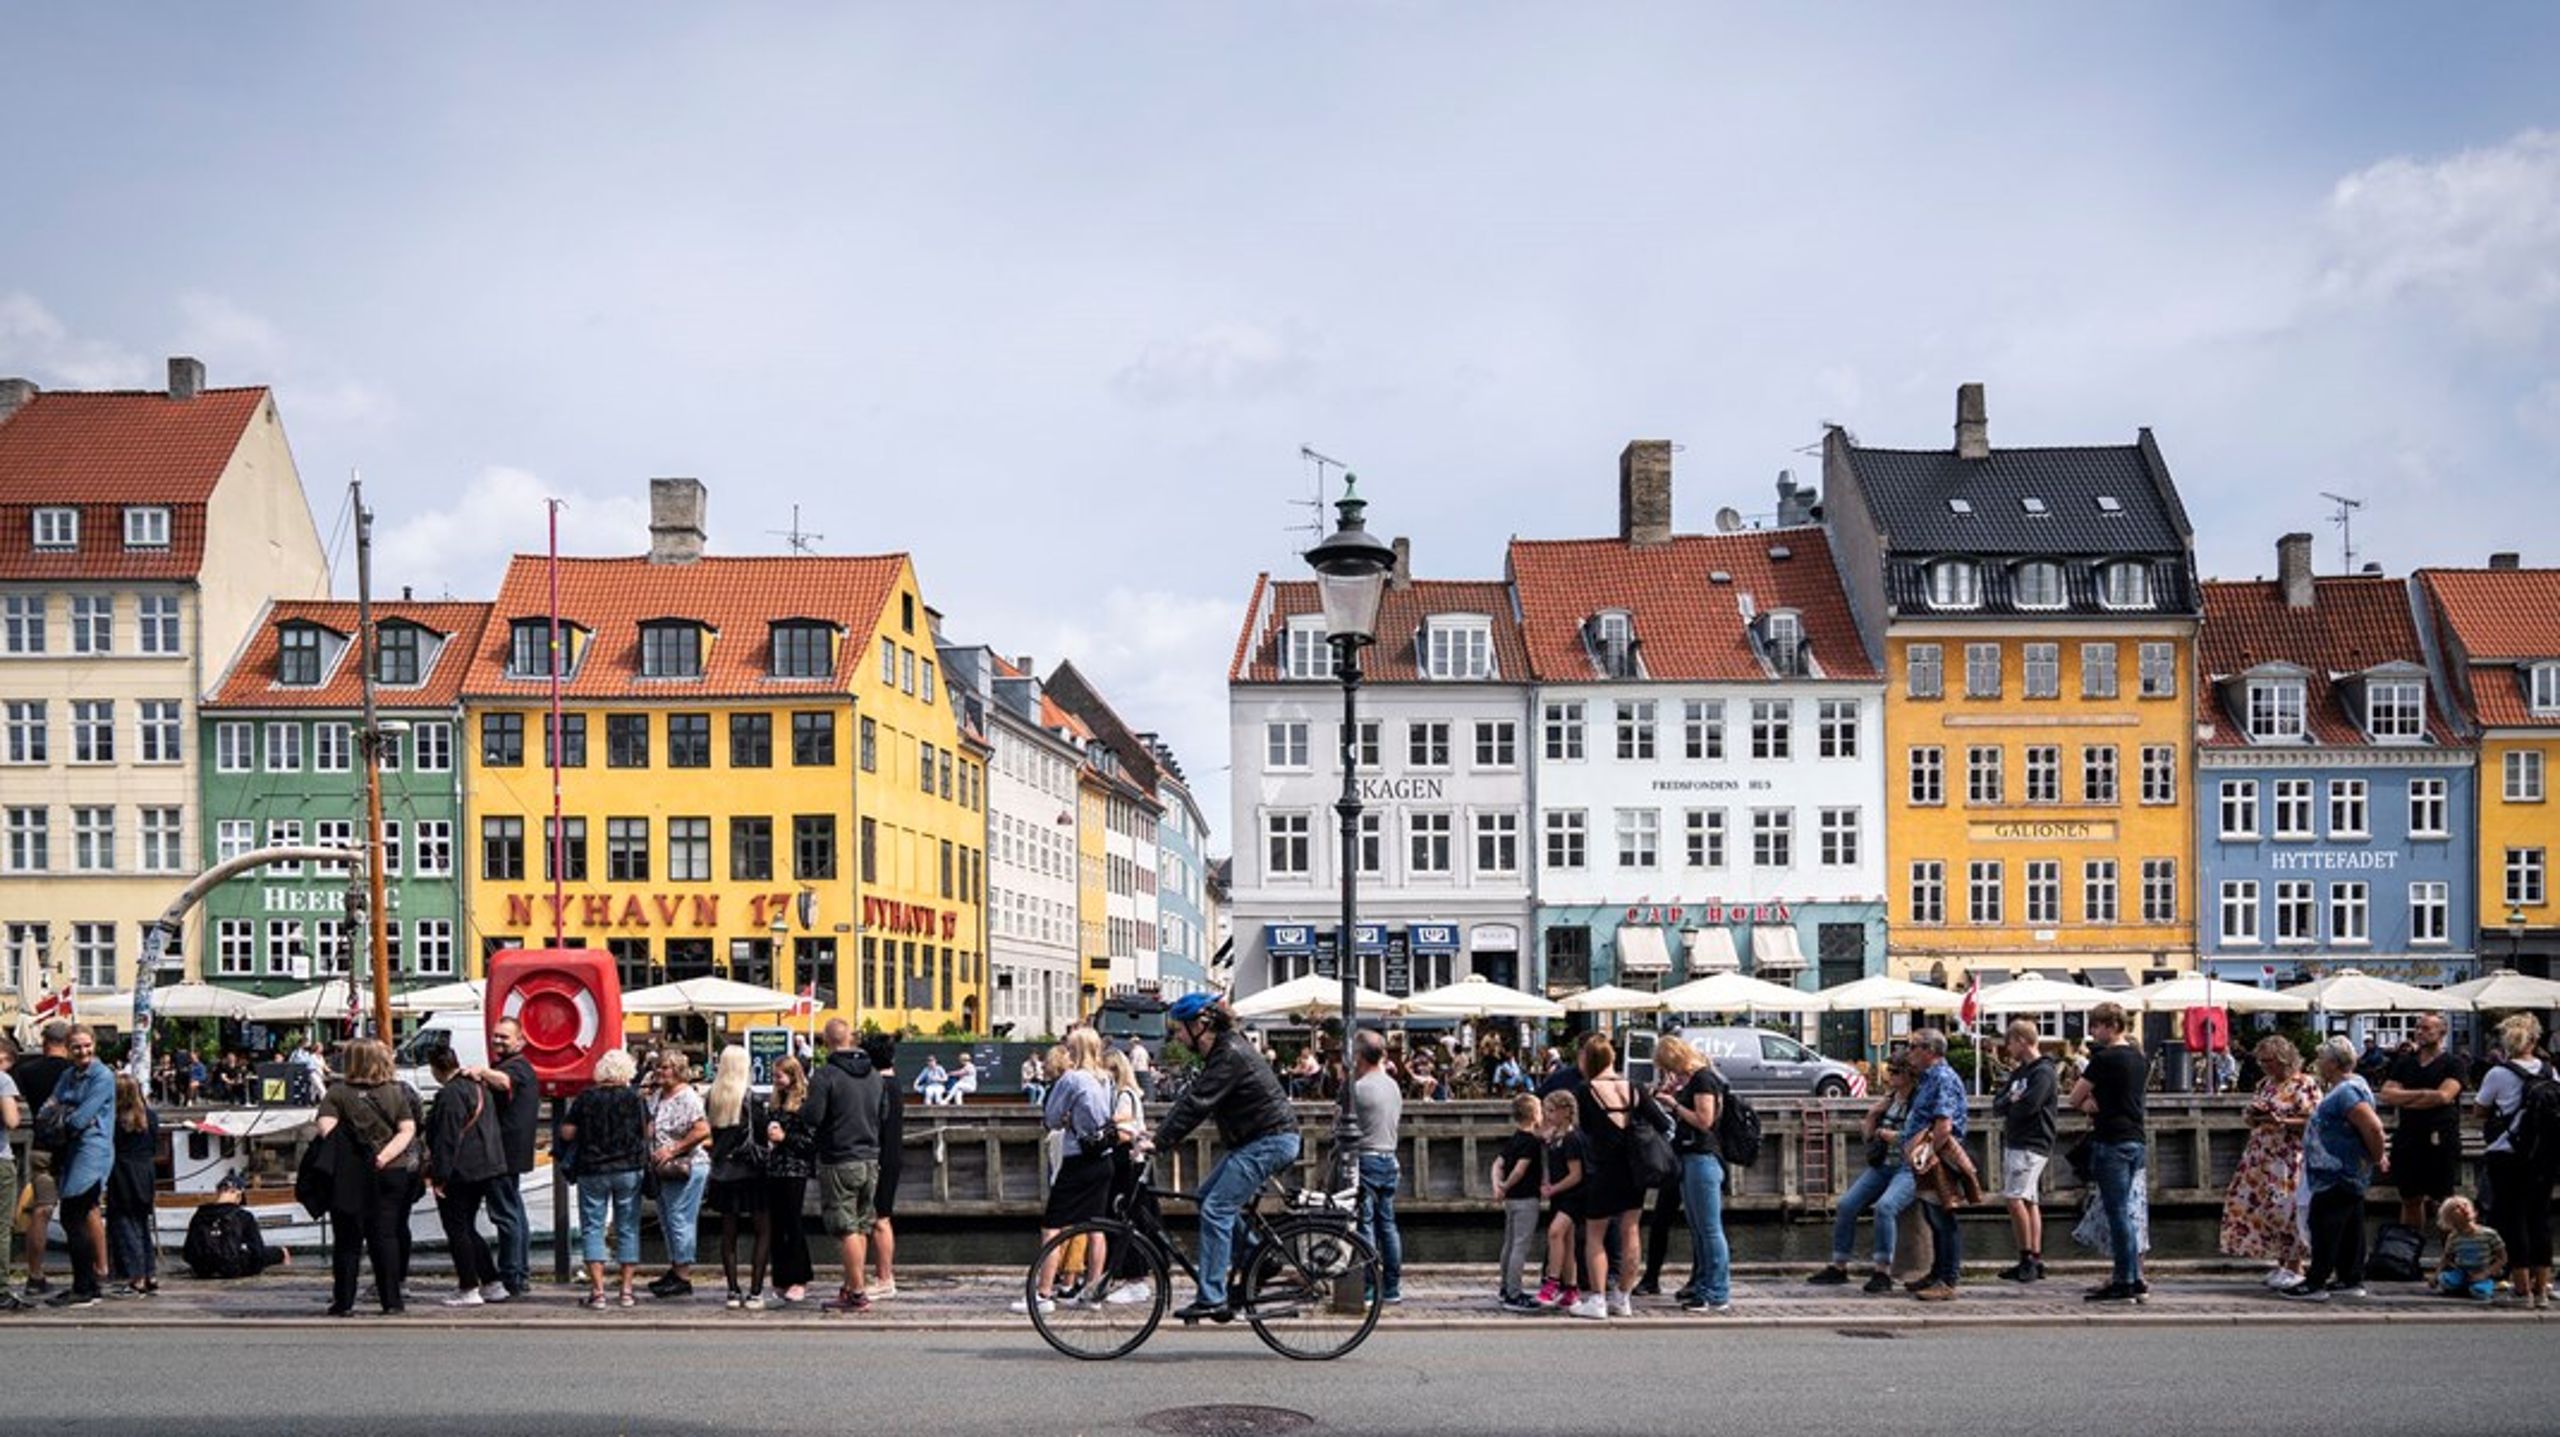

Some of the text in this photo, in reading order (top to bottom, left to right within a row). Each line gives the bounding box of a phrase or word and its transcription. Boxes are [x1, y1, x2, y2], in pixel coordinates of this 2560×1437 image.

[1994, 823, 2090, 838] GALIONEN
[2271, 851, 2399, 870] HYTTEFADET
[263, 886, 401, 912] HEERG
[506, 893, 792, 927] NYHAVN 17
[862, 895, 958, 941] NYHAVN 17
[1626, 905, 1792, 924] CAP HORN
[1690, 1036, 1736, 1058] City
